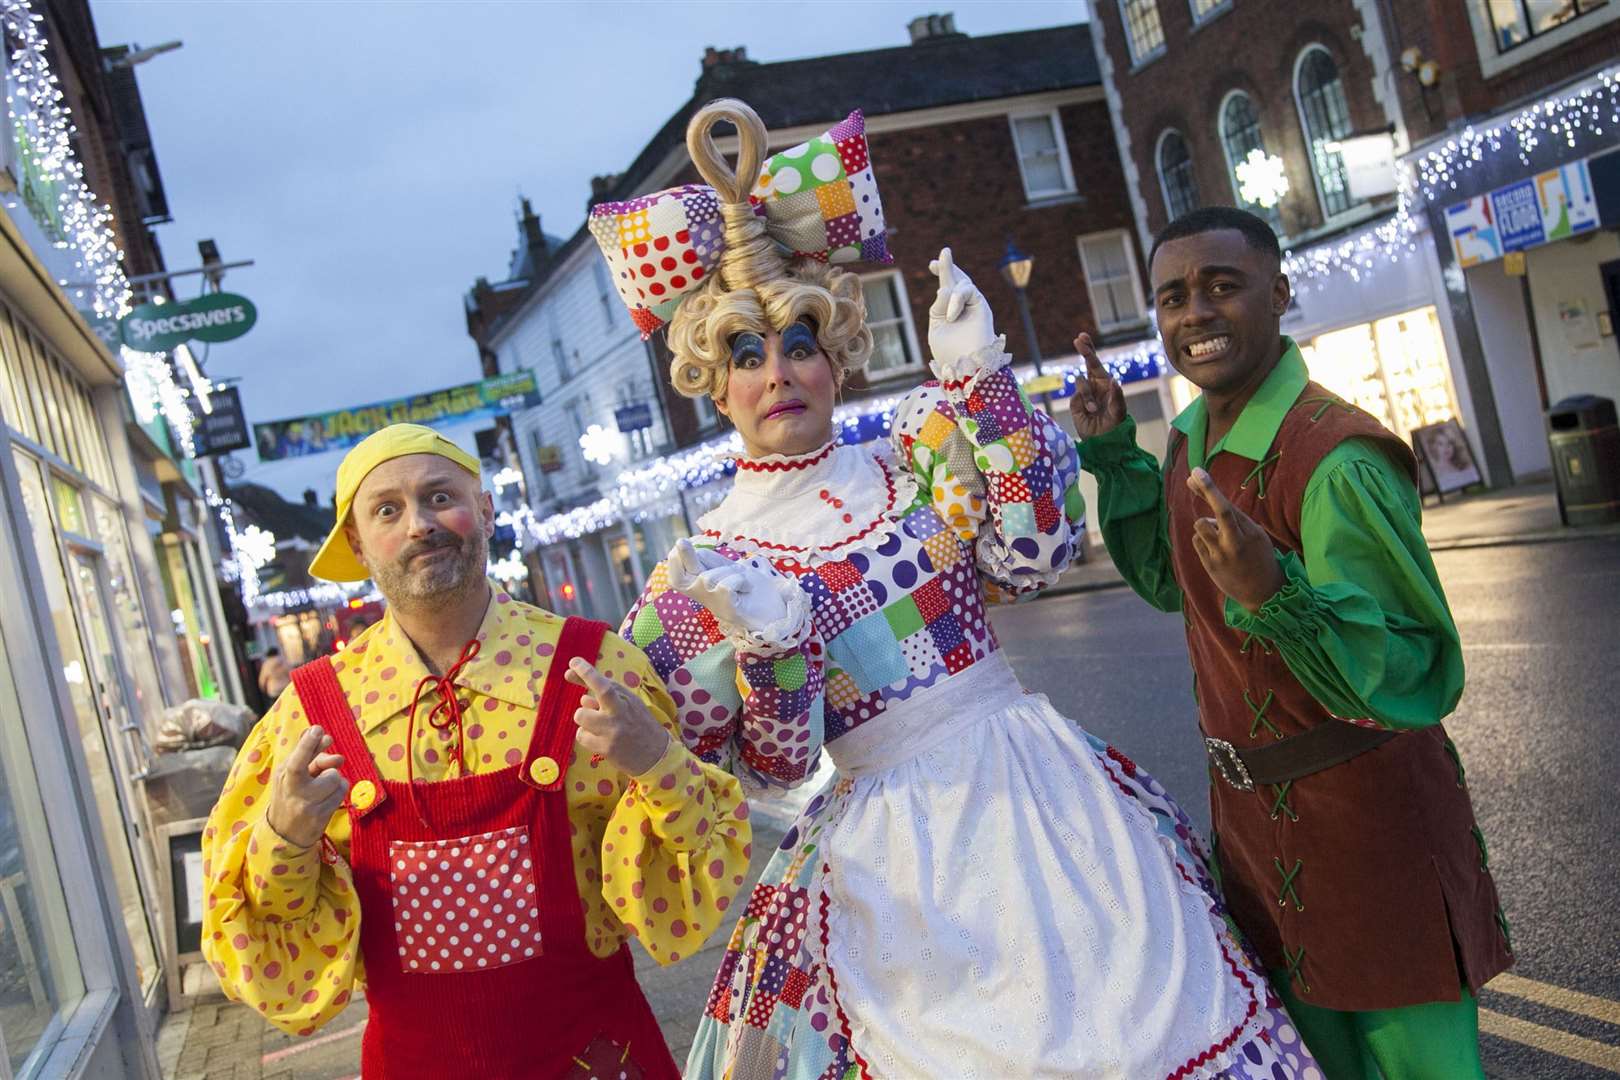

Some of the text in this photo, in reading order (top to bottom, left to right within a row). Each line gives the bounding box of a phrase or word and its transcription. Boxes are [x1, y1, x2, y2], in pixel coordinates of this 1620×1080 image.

[1498, 203, 1541, 237] FLOOR
[129, 305, 246, 341] Specsavers
[324, 406, 386, 438] JACK
